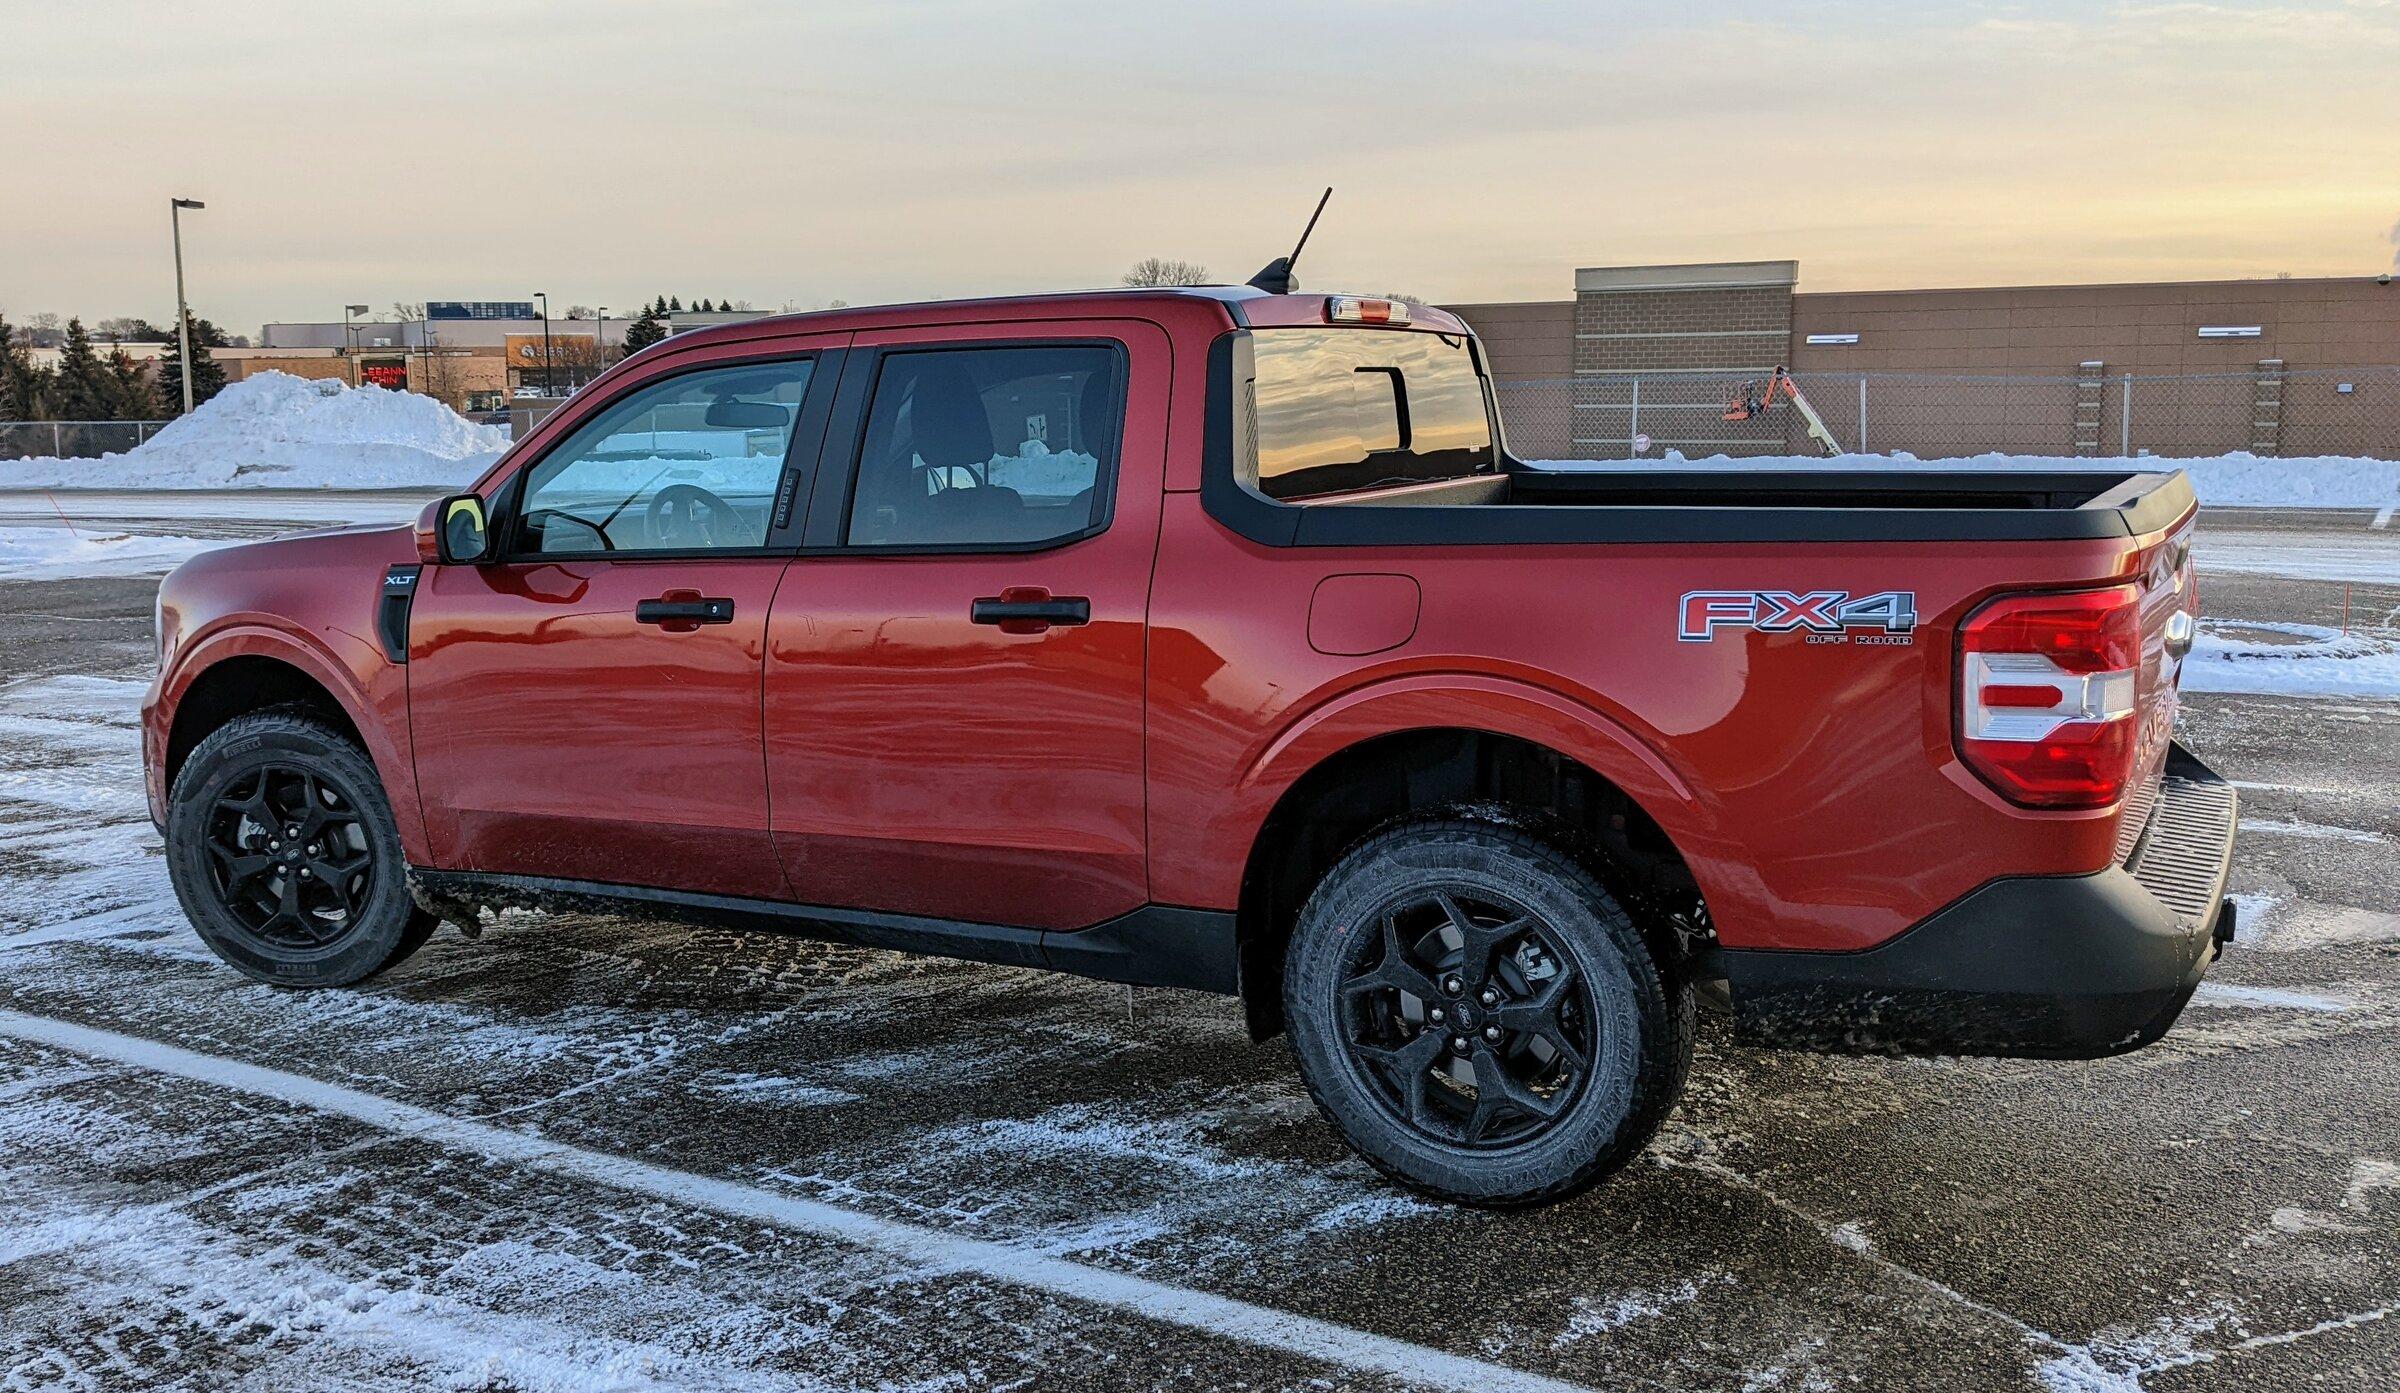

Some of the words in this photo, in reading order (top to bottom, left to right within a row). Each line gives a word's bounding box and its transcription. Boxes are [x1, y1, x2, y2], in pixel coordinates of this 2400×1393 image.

[371, 376, 398, 385] CHIN
[384, 576, 415, 585] XLT
[1678, 590, 1917, 642] FX4
[1805, 634, 1849, 644] OFF
[1855, 635, 1913, 646] ROAD
